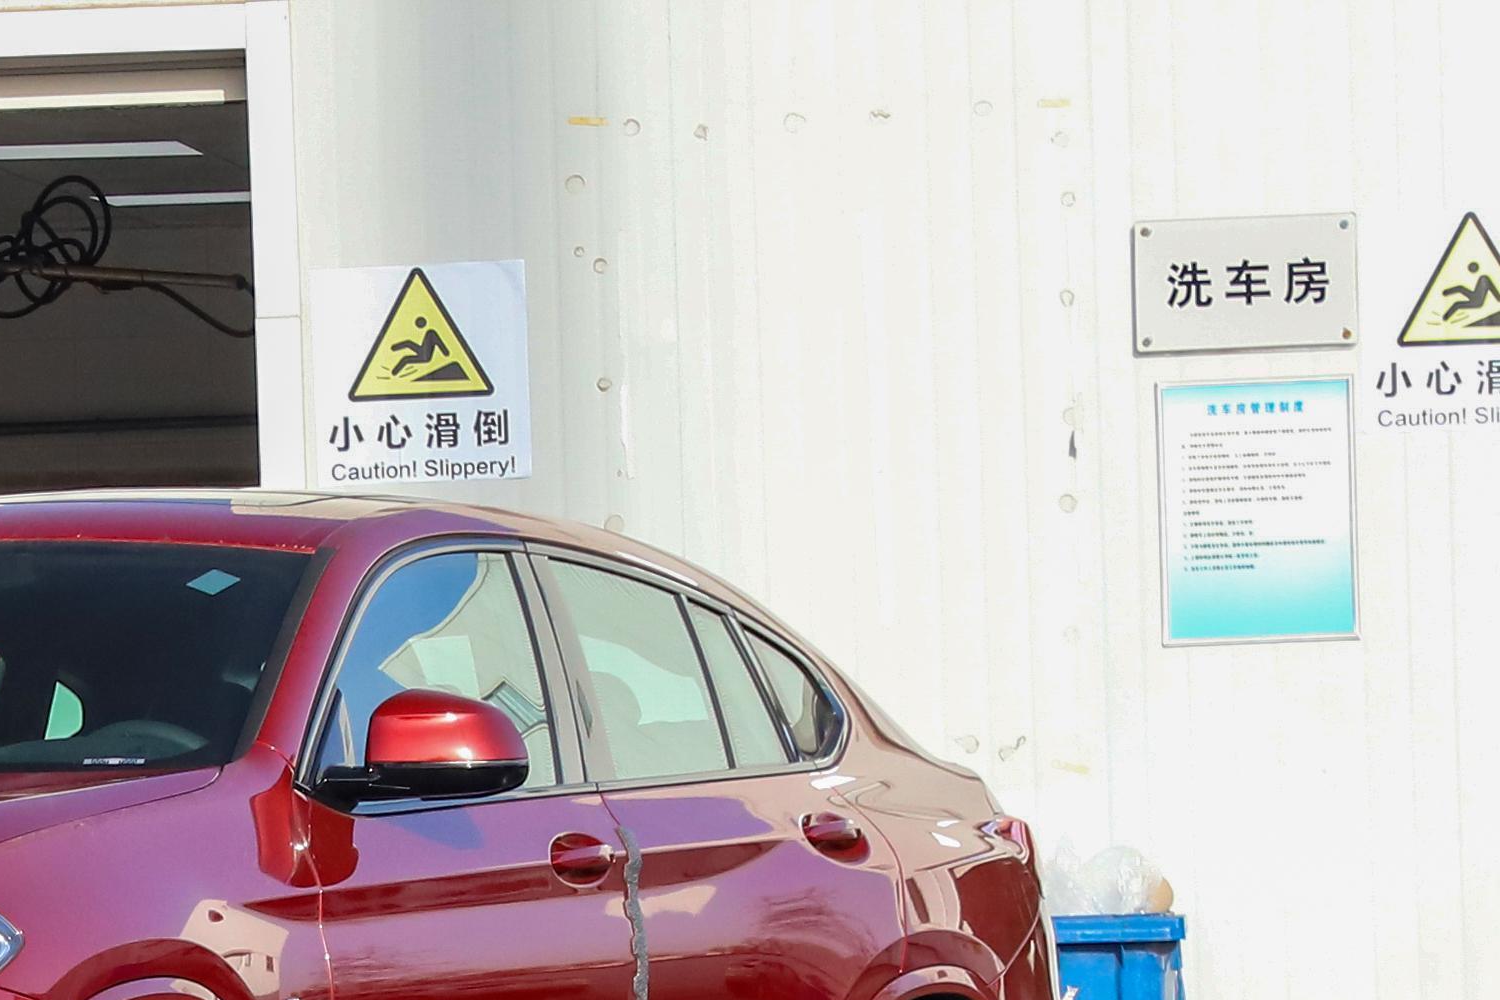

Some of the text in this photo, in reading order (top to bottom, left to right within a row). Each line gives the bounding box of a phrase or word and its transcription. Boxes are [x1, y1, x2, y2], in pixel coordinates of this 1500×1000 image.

[1167, 257, 1330, 308] 洗车房
[329, 408, 509, 452] 小心滑倒
[1377, 407, 1466, 427] Caution!
[331, 456, 516, 481] Caution! Slippery!
